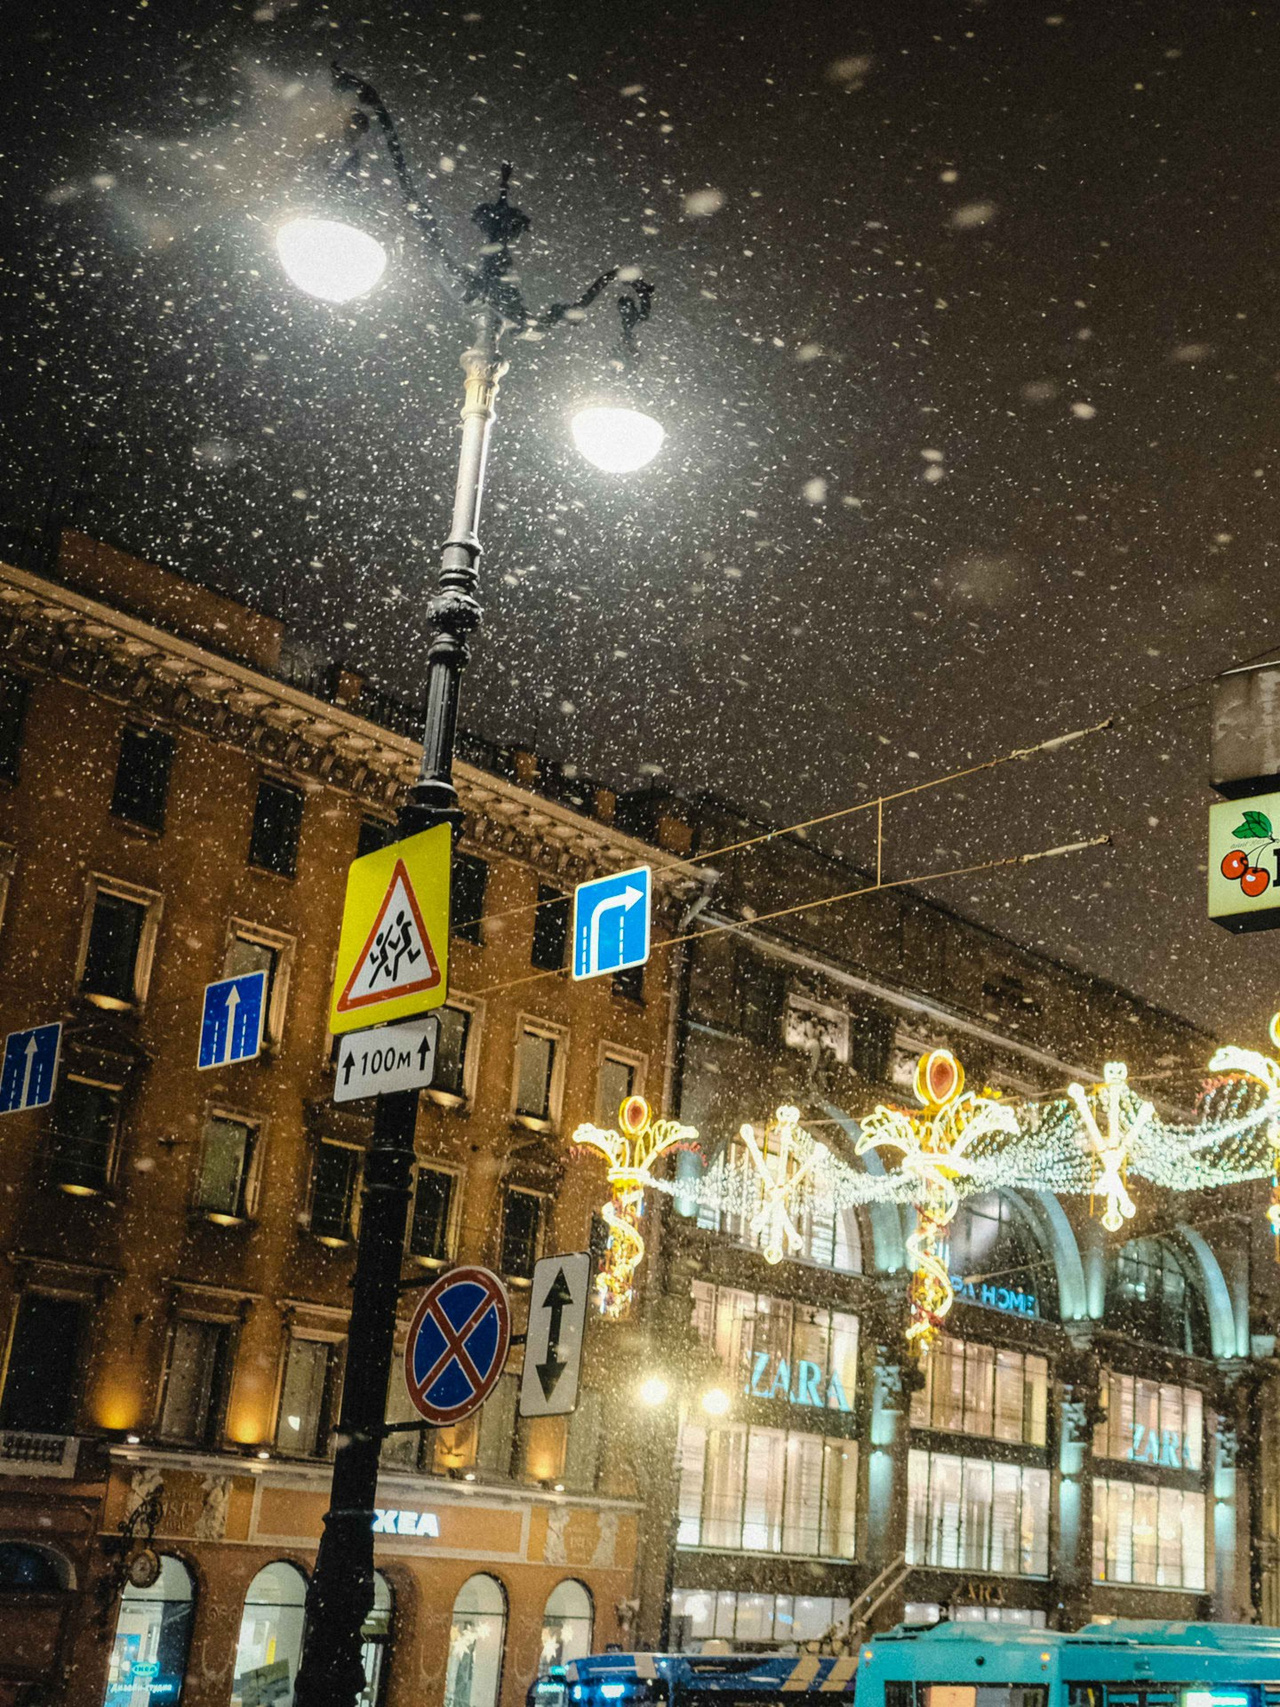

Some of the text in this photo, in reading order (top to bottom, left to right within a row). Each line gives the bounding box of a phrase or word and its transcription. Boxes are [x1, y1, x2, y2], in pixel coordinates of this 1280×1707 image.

[981, 1283, 1036, 1317] HOME
[744, 1349, 853, 1413] ZARA
[1127, 1421, 1200, 1472] ZARA
[371, 1507, 440, 1538] KEA
